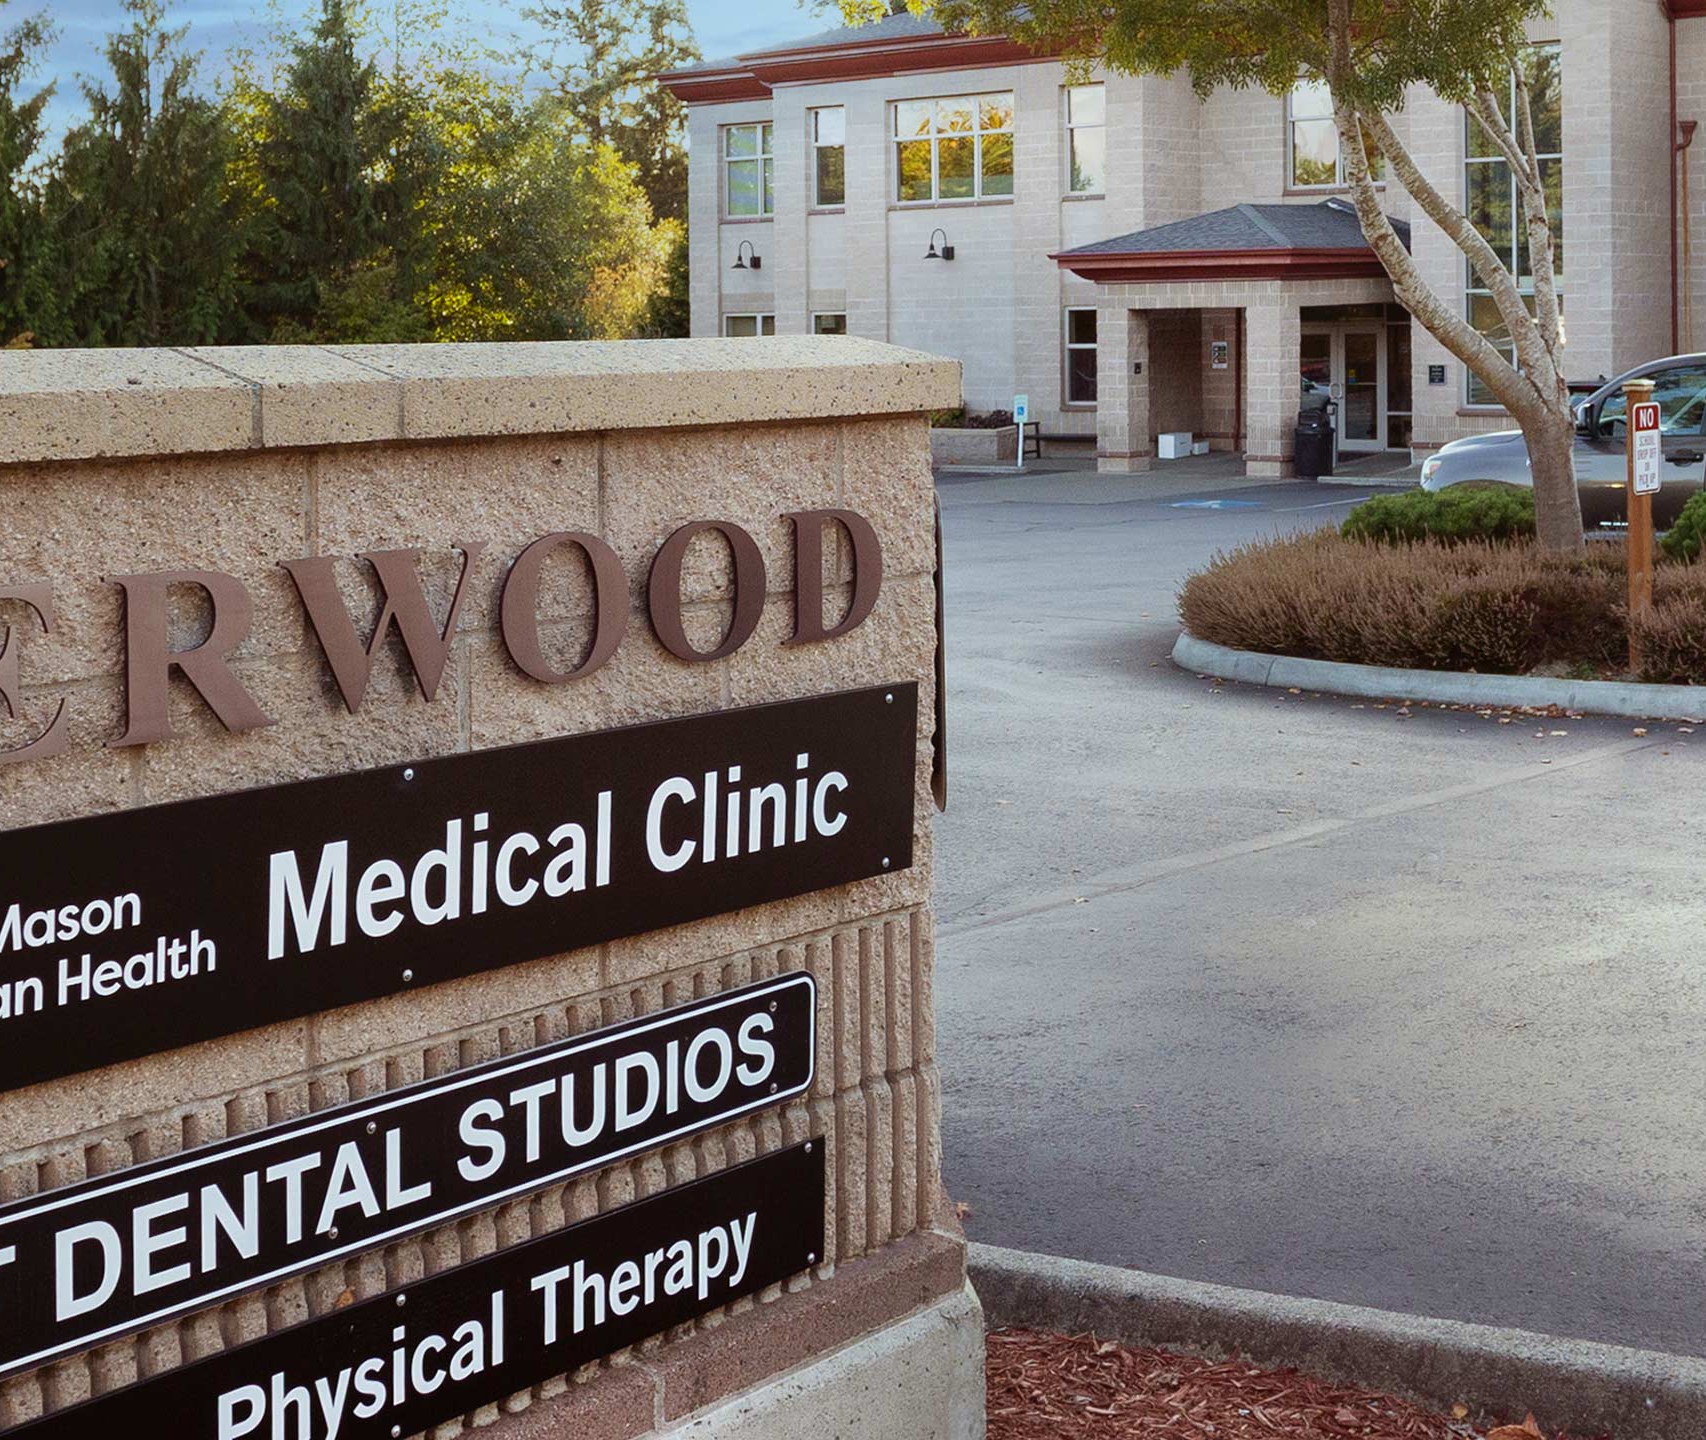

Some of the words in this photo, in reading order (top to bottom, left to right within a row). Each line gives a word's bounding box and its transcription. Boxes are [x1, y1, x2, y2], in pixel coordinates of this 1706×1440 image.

[1639, 408, 1654, 429] NO
[267, 790, 612, 961] Medical
[645, 752, 849, 873] Clinic
[58, 928, 216, 1006] Health
[55, 1127, 432, 1322] DENTAL
[456, 1012, 775, 1182] STUDIOS
[217, 1289, 504, 1440] Physical
[530, 1211, 757, 1346] Therapy
